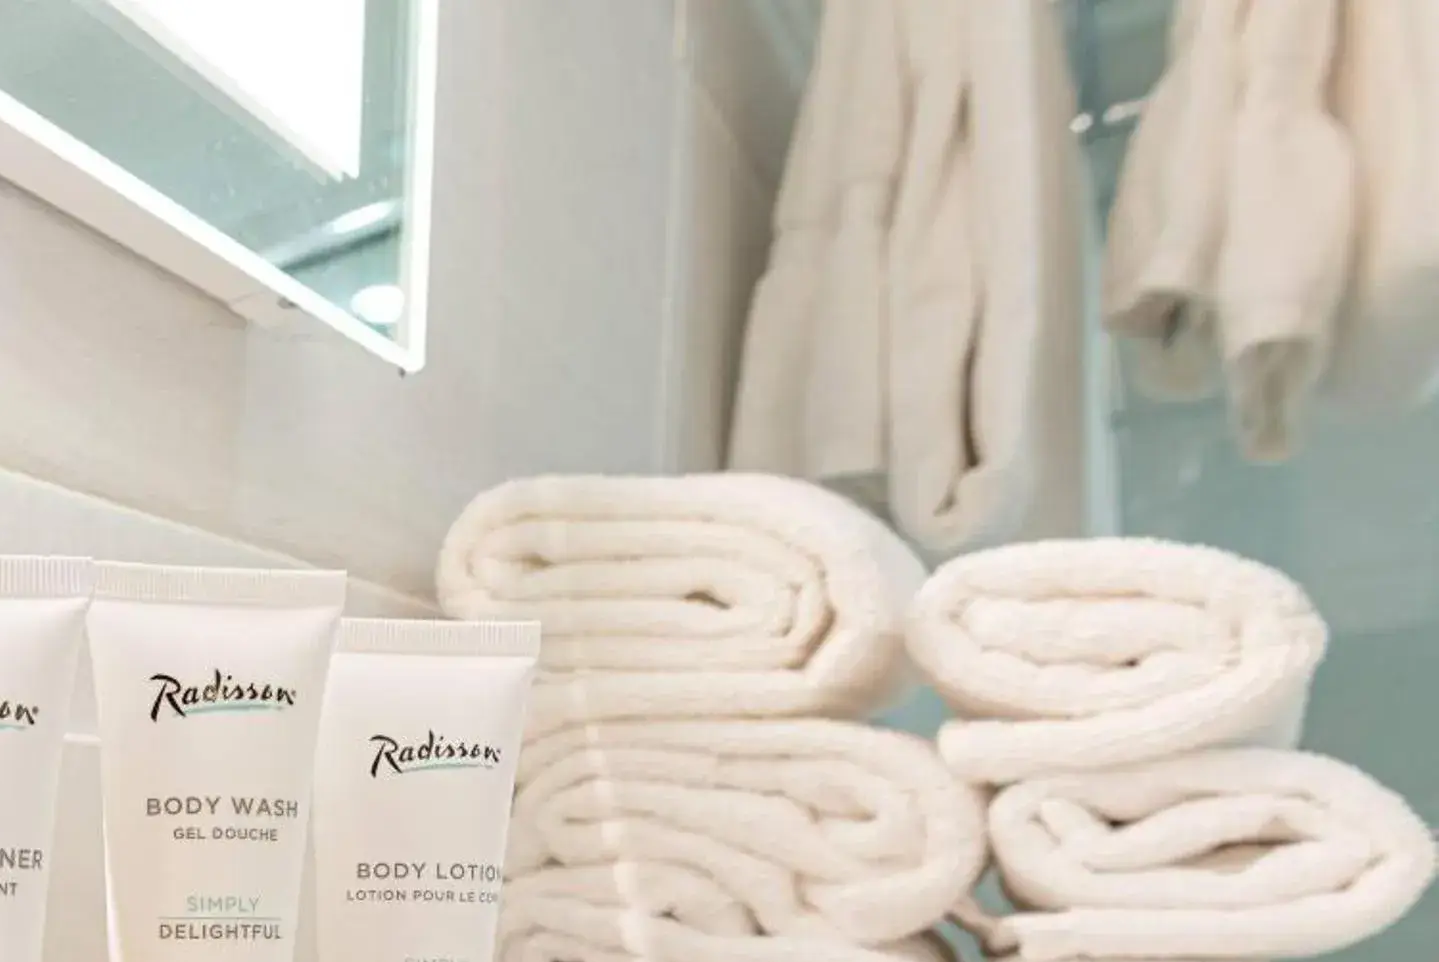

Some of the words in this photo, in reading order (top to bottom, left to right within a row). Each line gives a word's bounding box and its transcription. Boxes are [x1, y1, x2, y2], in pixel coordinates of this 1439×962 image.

[150, 669, 295, 722] Radisson
[370, 730, 501, 778] Radisson
[147, 797, 221, 817] BODY
[231, 797, 298, 818] WASH
[173, 826, 206, 840] GEL
[212, 826, 278, 841] DOUCHE
[357, 862, 427, 881] BODY
[186, 896, 261, 914] SIMPLY
[346, 889, 407, 903] LOTION
[412, 889, 455, 902] POUR
[459, 889, 476, 903] LE
[159, 923, 281, 941] DELIGHTFUL
